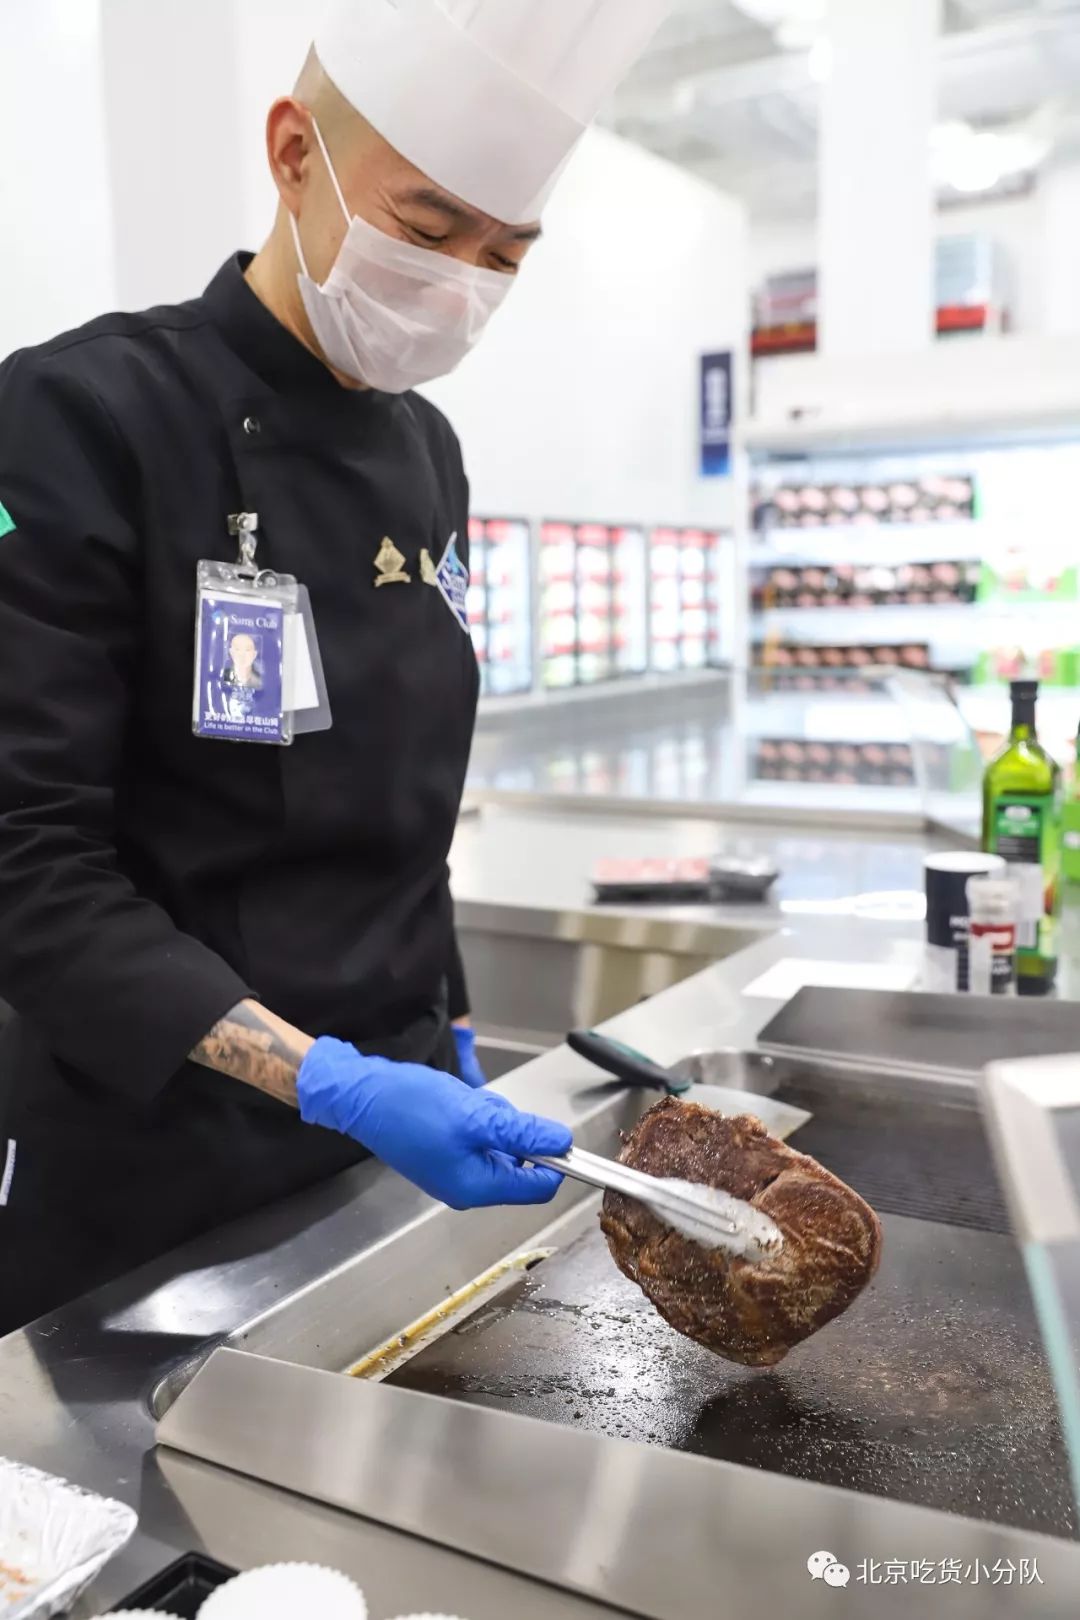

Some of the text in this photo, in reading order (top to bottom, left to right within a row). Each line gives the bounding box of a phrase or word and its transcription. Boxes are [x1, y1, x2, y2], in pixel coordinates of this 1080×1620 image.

[255, 616, 278, 629] Club
[204, 722, 216, 730] Life
[224, 723, 244, 732] better
